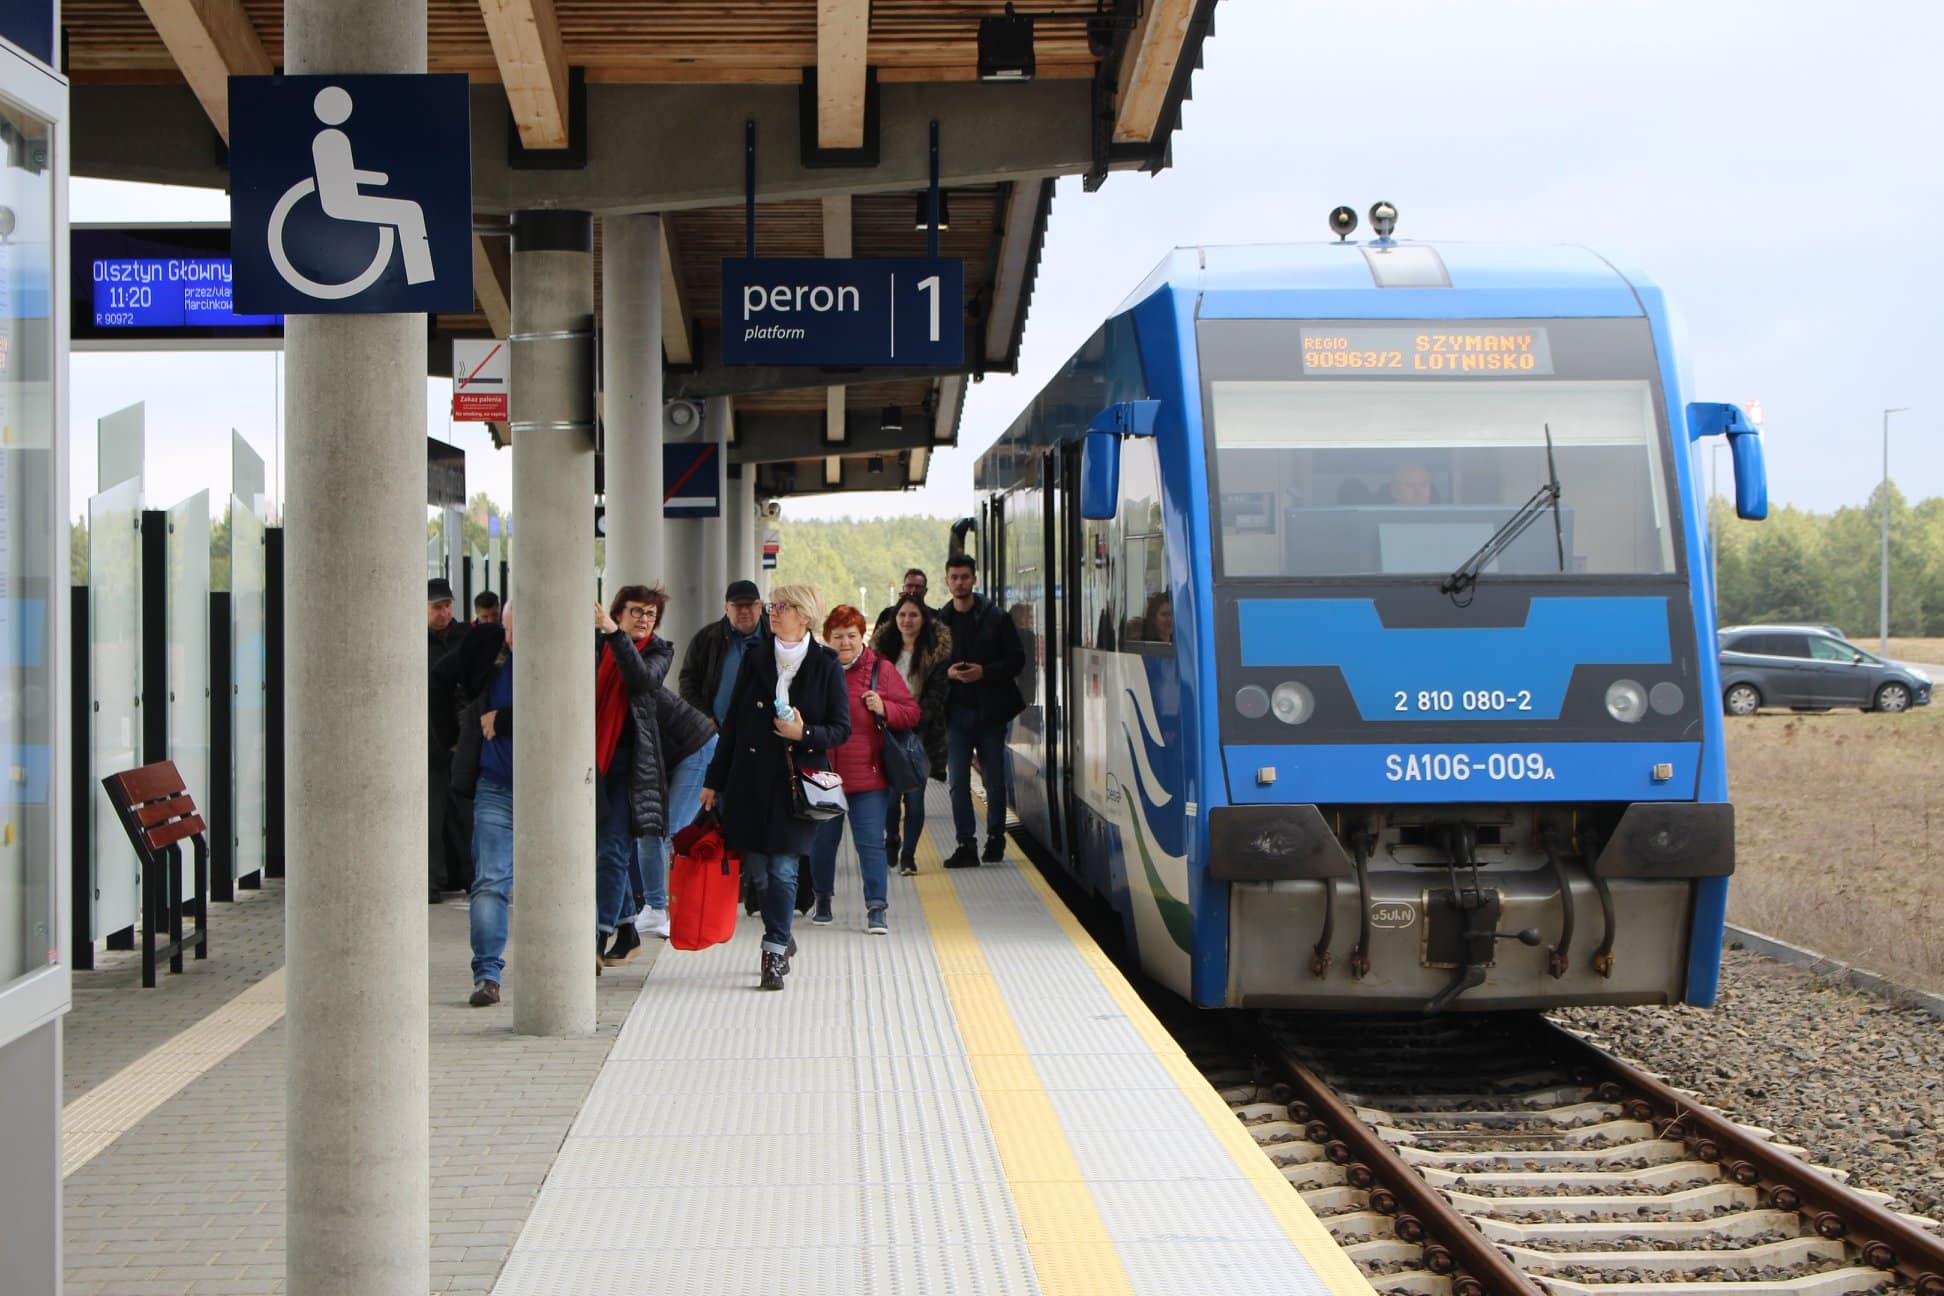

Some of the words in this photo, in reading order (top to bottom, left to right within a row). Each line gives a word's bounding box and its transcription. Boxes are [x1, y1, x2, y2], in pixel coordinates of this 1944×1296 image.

[93, 260, 162, 283] Olsztyn
[168, 260, 232, 282] Główny
[109, 287, 152, 308] 11:20
[184, 285, 232, 299] przez/via
[743, 285, 860, 321] peron
[917, 275, 940, 341] 1
[96, 313, 103, 325] R
[105, 312, 134, 325] 90972
[744, 324, 805, 342] platform
[1303, 337, 1348, 350] REGIO
[1415, 335, 1532, 351] SZYMANY
[1304, 351, 1402, 368] 90963/2
[1413, 353, 1535, 369] LOTNISKO
[1394, 691, 1408, 711] 2
[1417, 690, 1453, 711] 810
[1462, 690, 1532, 711] 080-2
